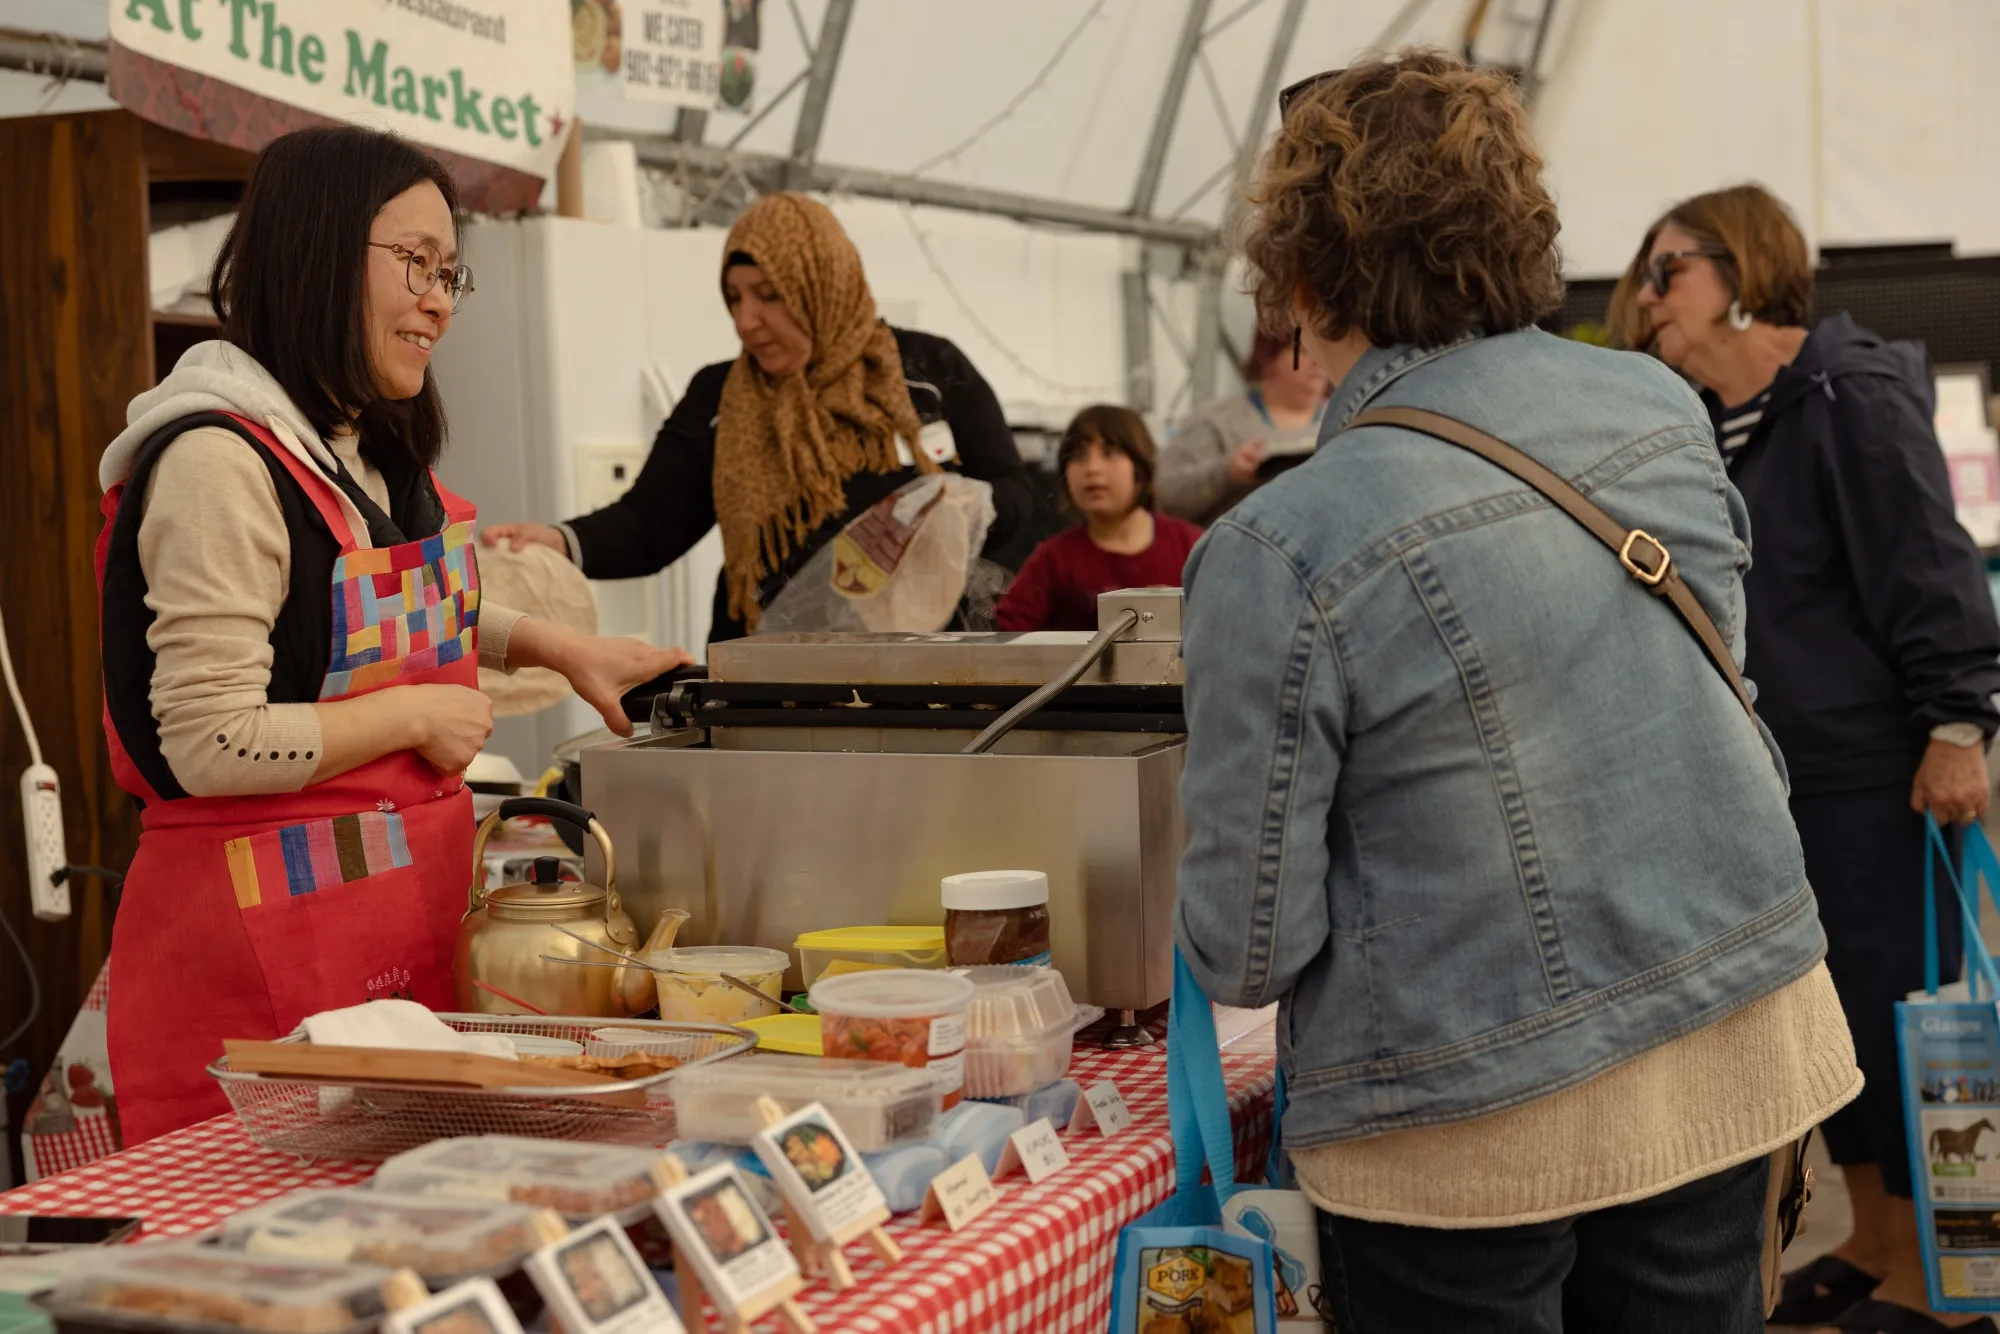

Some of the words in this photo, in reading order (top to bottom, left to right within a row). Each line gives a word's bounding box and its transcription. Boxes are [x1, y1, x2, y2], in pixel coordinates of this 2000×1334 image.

[219, 0, 327, 84] The
[343, 29, 543, 148] Market
[1157, 1267, 1200, 1283] PORK
